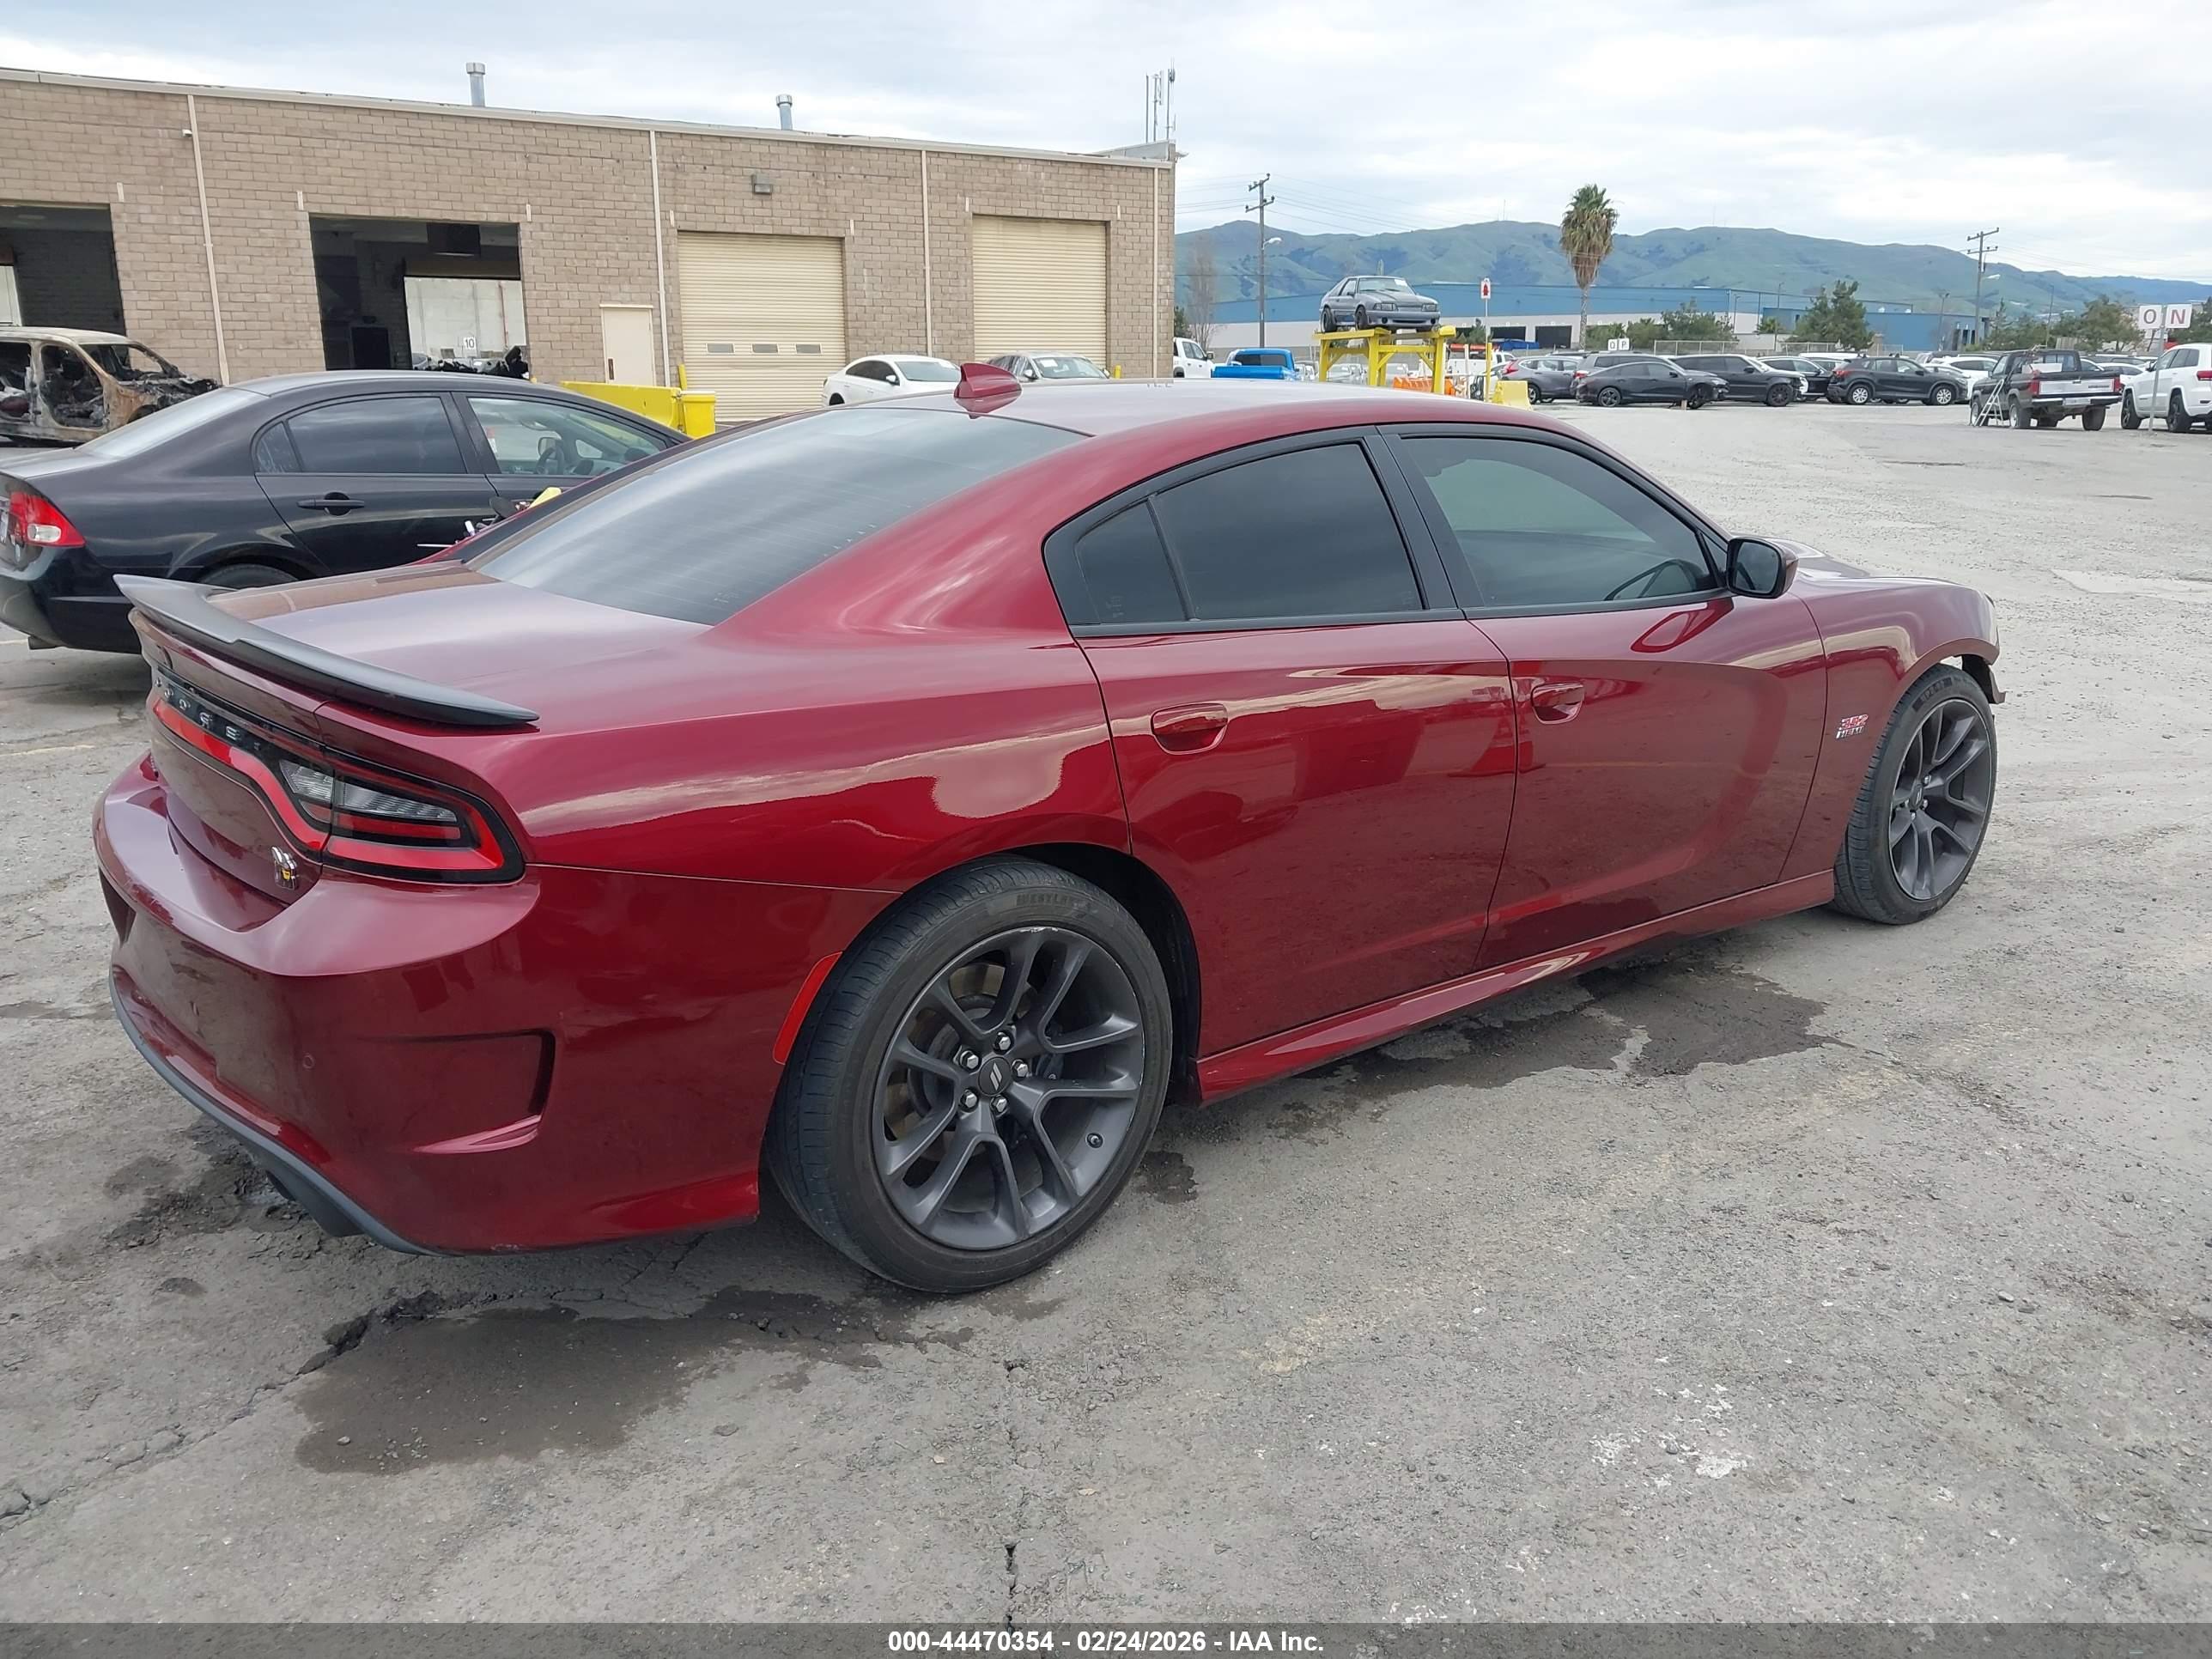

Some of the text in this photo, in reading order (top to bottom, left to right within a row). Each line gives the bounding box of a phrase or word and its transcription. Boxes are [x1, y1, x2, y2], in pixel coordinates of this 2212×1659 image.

[2143, 308, 2186, 325] O N
[465, 337, 475, 349] 10
